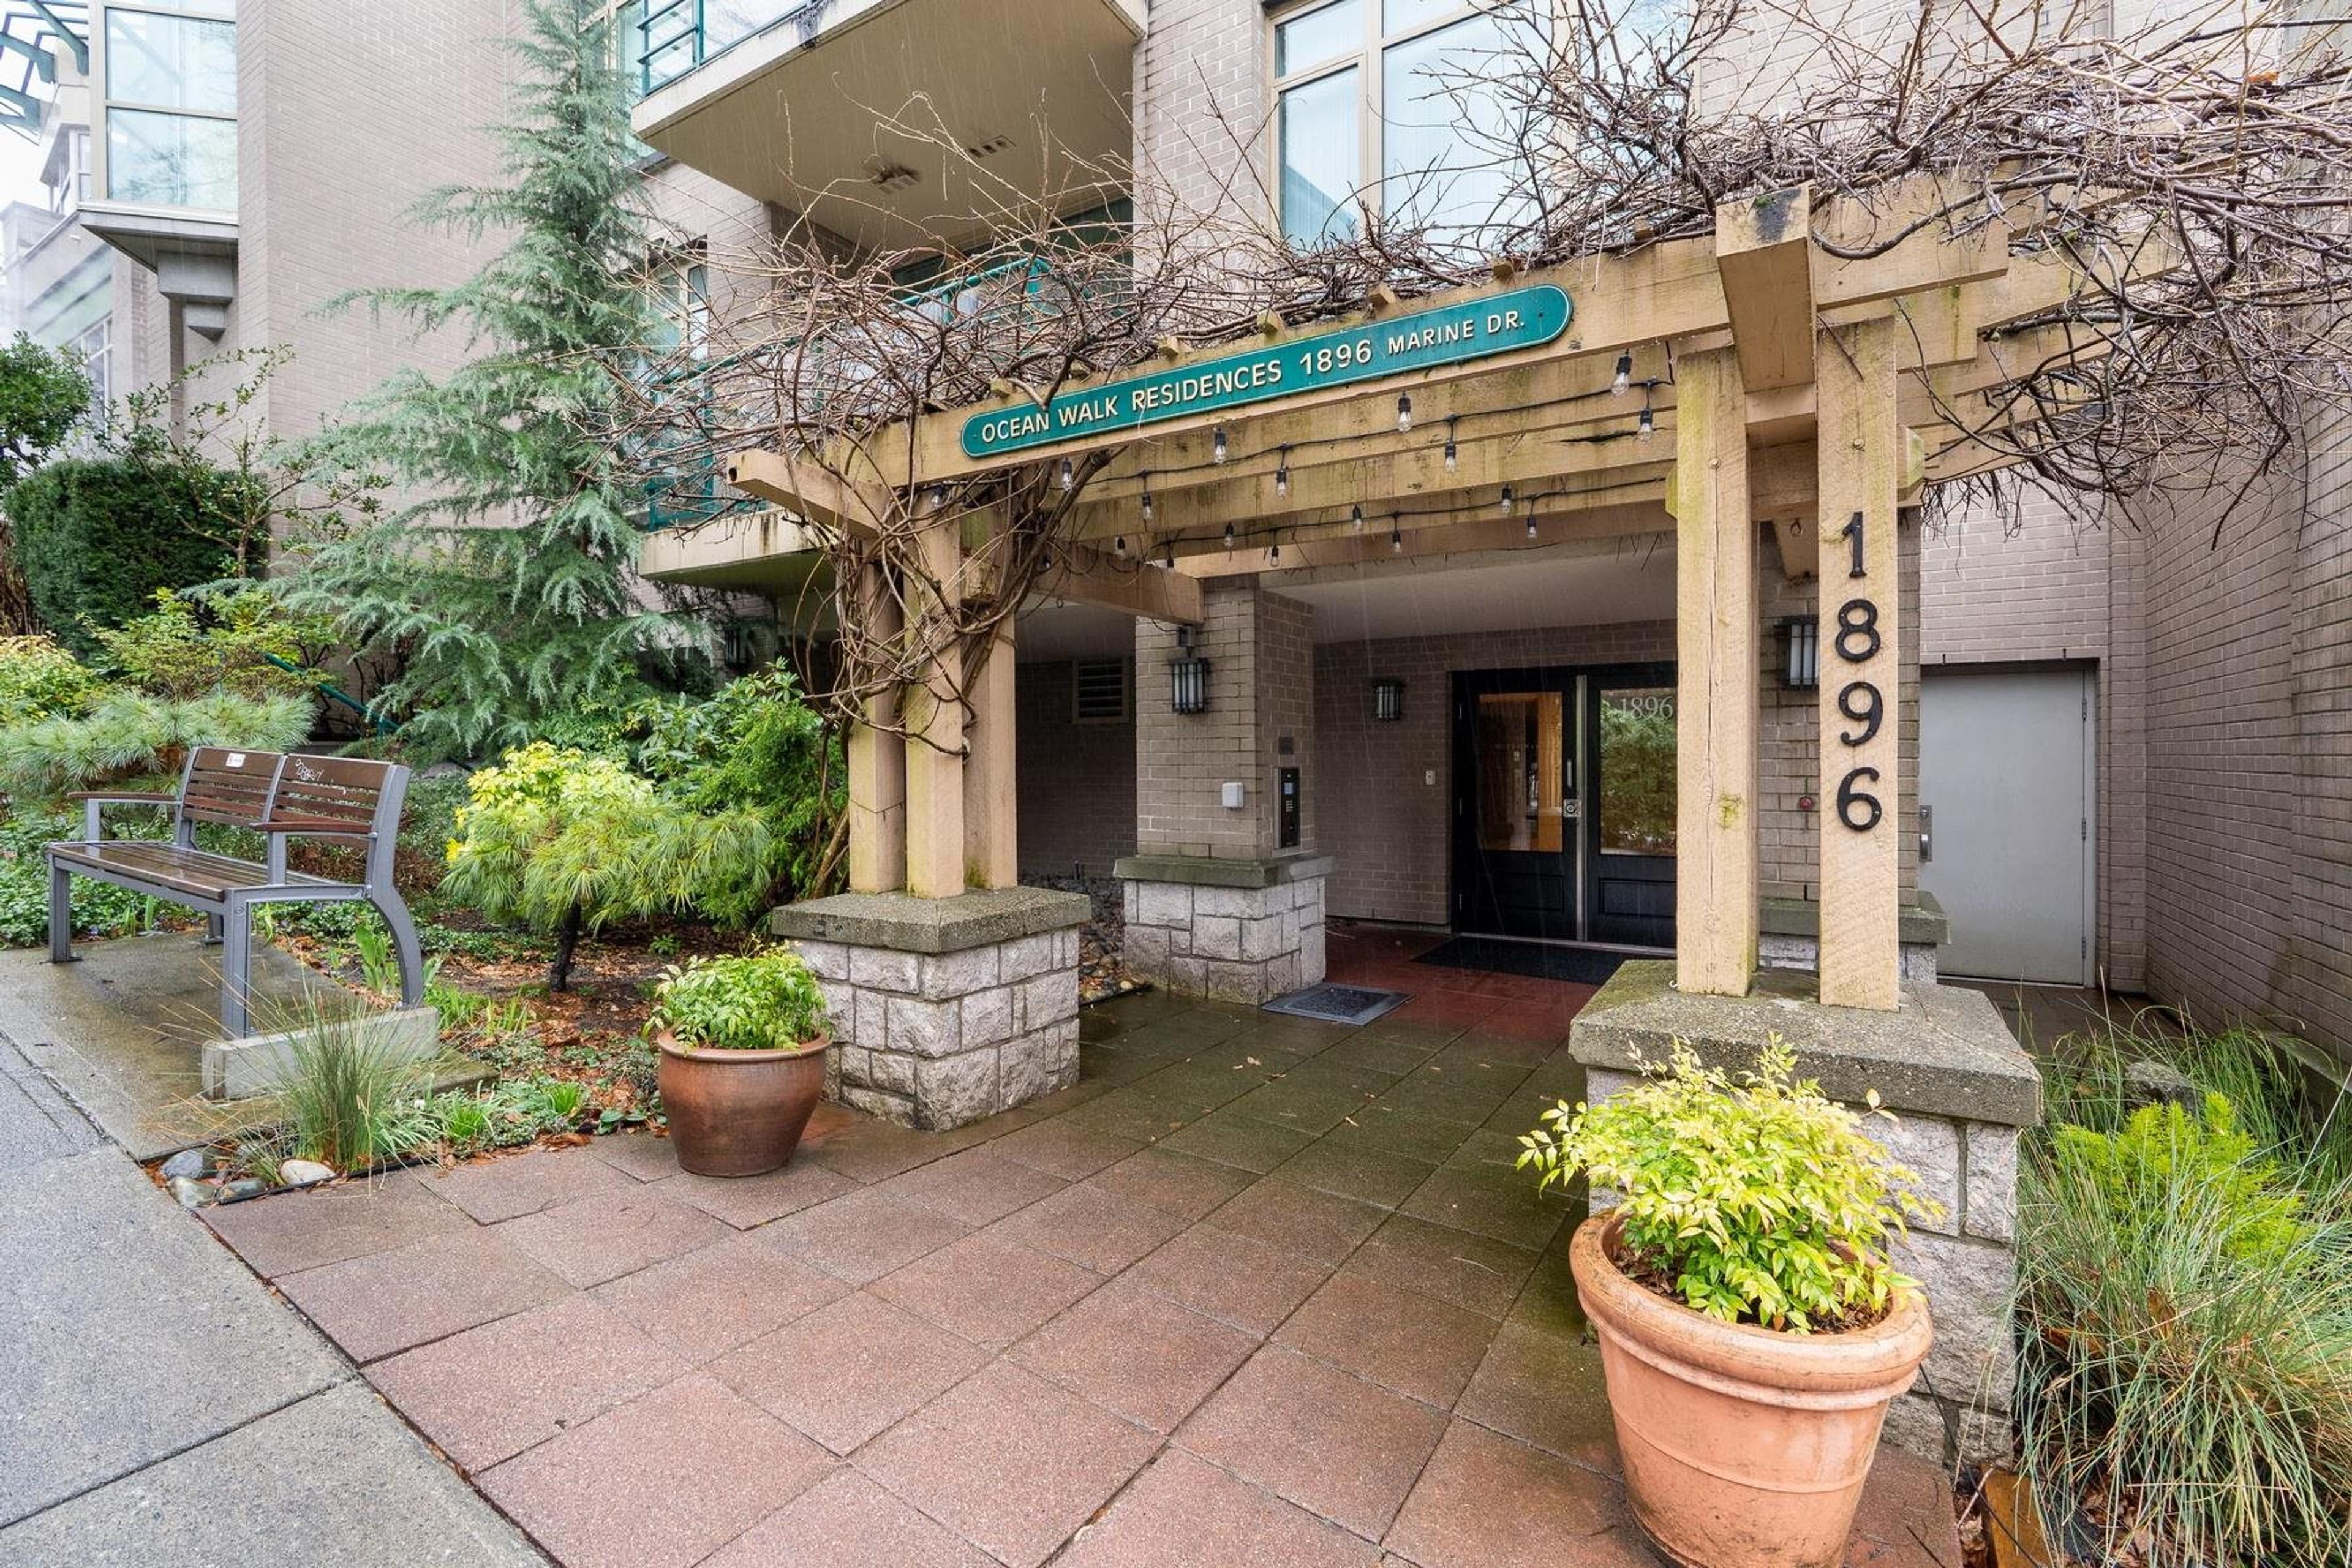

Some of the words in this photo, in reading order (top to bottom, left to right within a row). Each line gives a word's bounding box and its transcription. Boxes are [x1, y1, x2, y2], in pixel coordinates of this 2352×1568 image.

[982, 411, 1050, 443] OCEAN
[1058, 395, 1118, 427] WALK
[1132, 360, 1283, 411] RESIDENCES
[1300, 339, 1373, 375] 1896
[1387, 319, 1474, 355] MARINE
[1487, 310, 1526, 333] DR.
[1620, 695, 1674, 720] 1896
[1835, 511, 1883, 832] 1896
